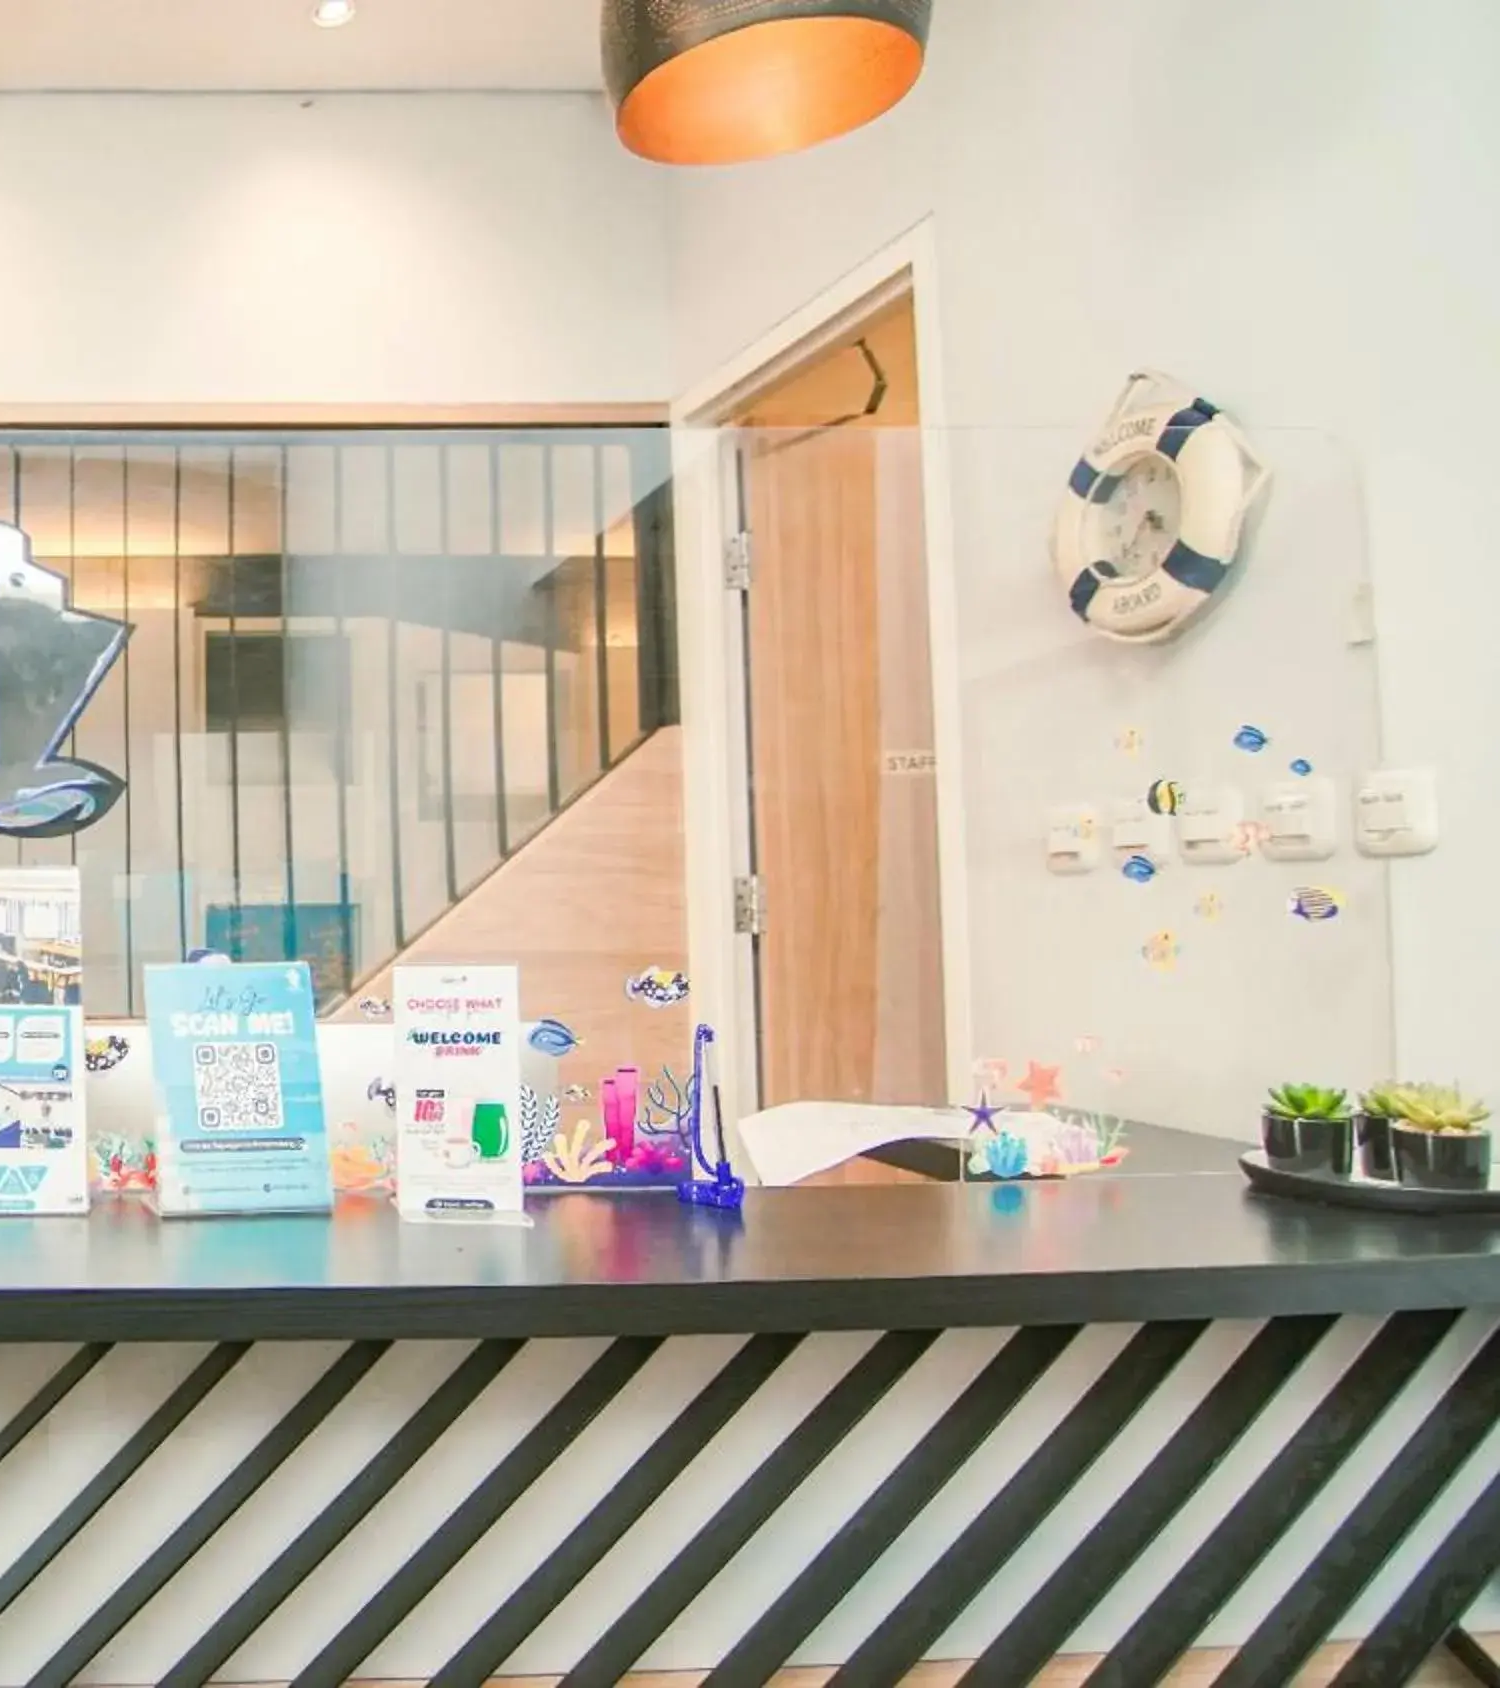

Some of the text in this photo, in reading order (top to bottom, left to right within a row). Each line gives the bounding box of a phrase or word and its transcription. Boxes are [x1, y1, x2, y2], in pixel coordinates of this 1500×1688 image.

[406, 997, 503, 1010] CHOOSE WHAT
[171, 1010, 295, 1037] SCAN ME!
[411, 1031, 501, 1045] WELCOME
[435, 1045, 483, 1058] DRINK
